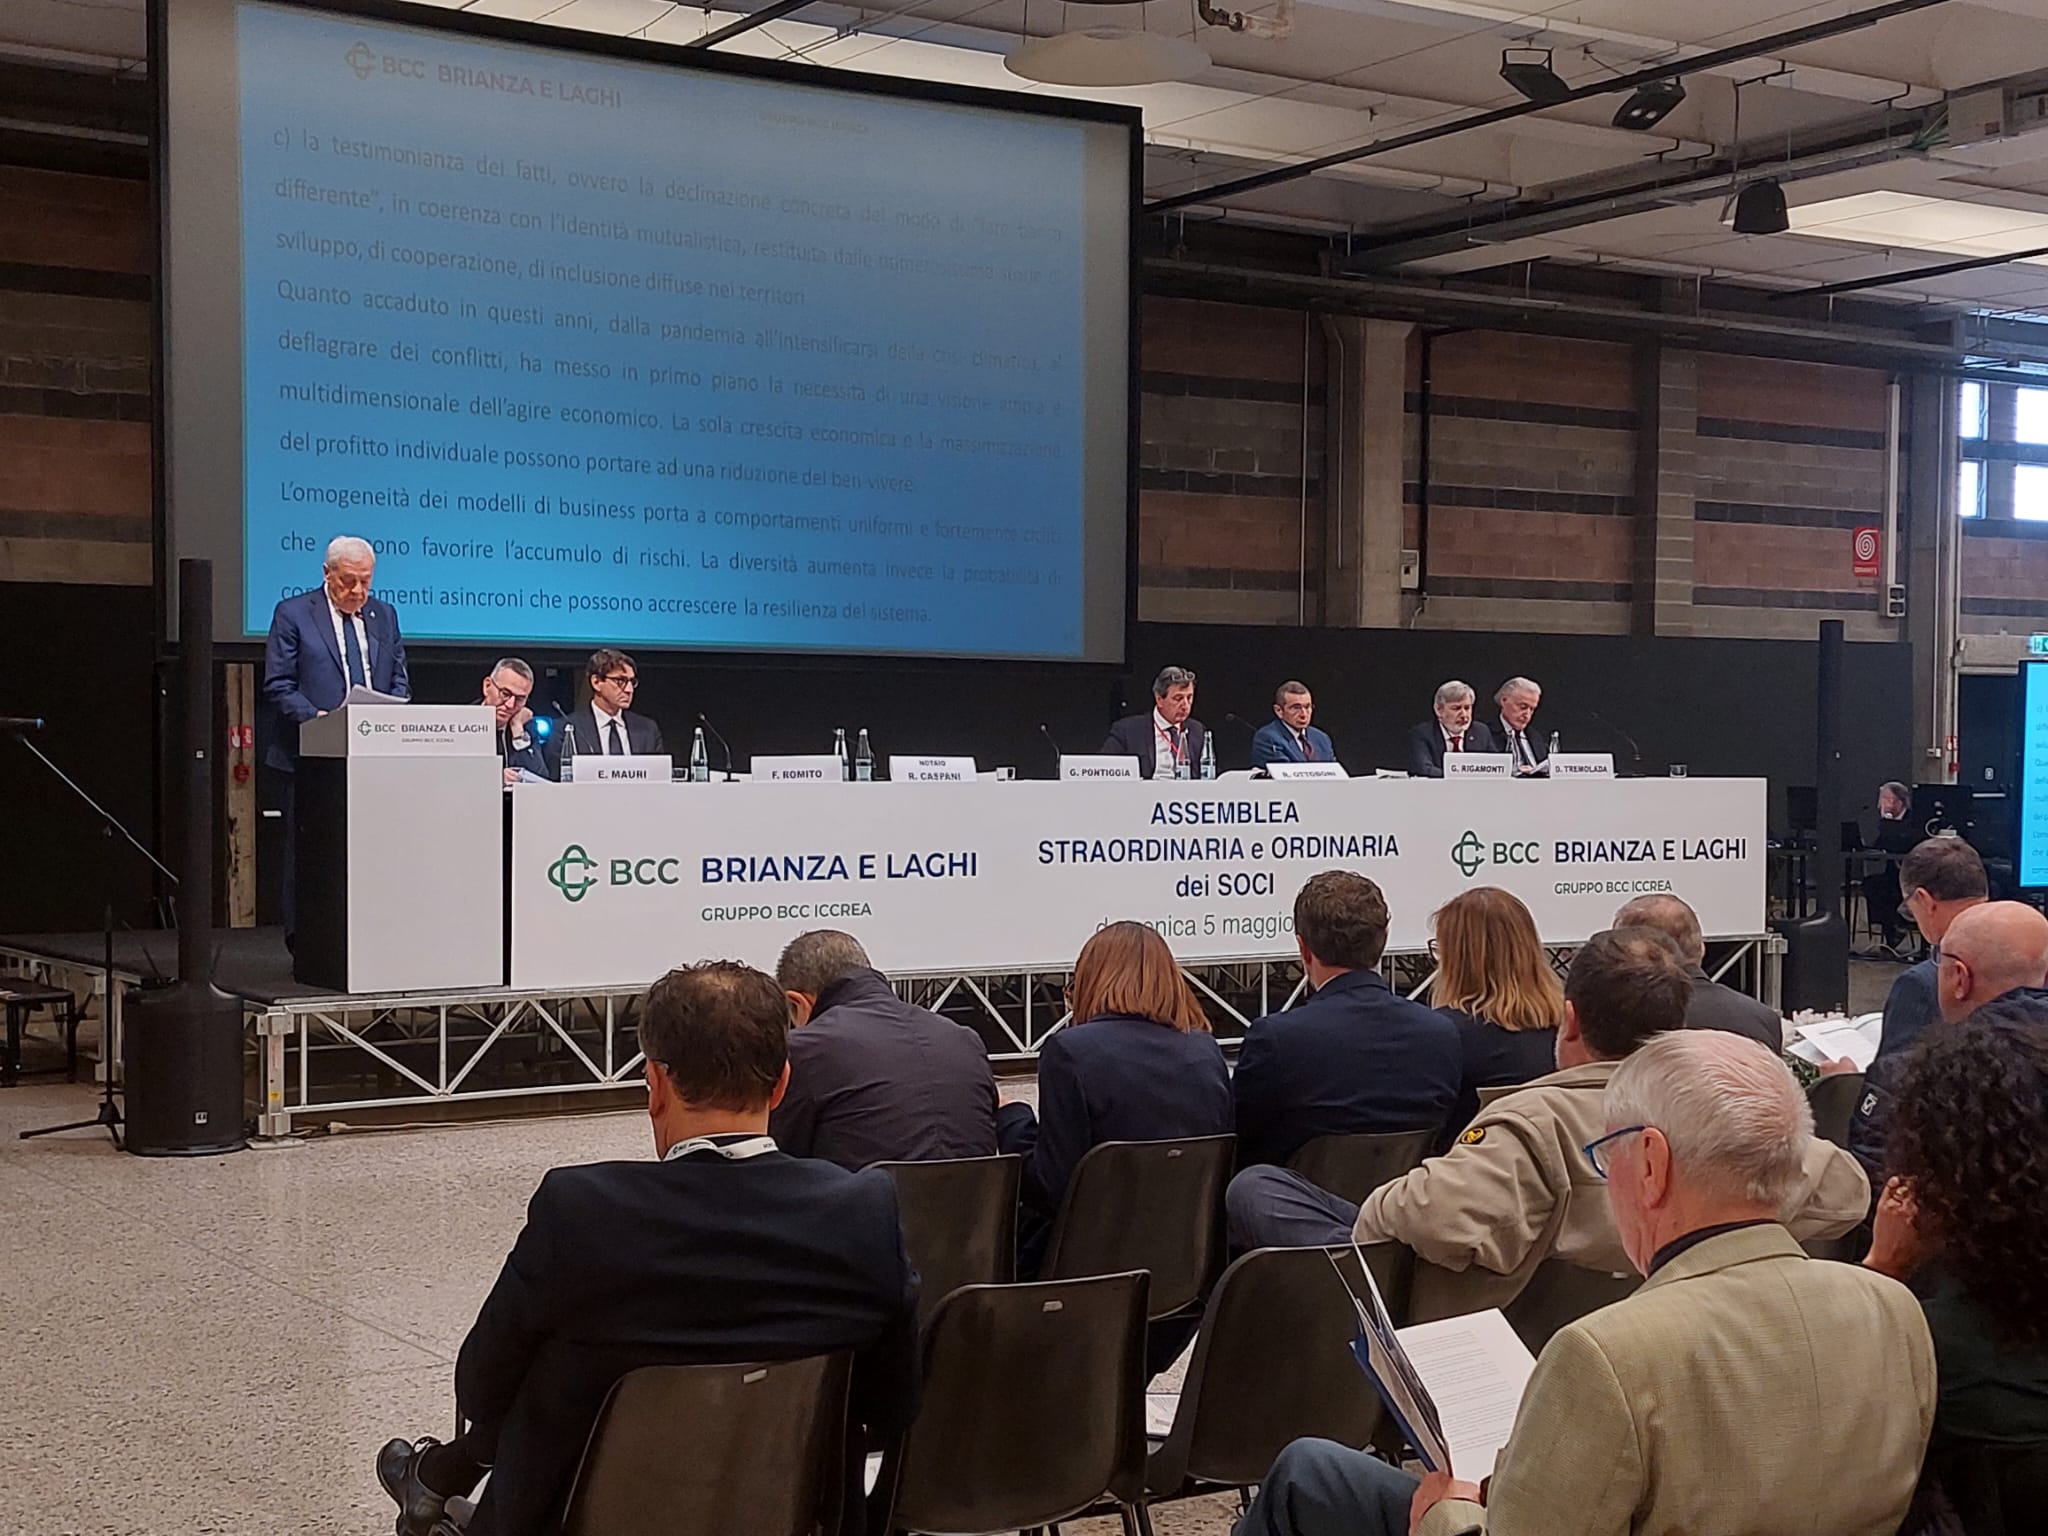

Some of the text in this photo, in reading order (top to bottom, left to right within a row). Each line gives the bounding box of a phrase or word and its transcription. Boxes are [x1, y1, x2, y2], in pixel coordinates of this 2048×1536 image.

[383, 57, 621, 108] BCC BRIANZA E LAGHI
[273, 128, 290, 149] c)
[303, 131, 320, 151] la
[332, 137, 464, 171] testimonianza
[477, 155, 504, 177] dei
[516, 160, 556, 187] fatti,
[568, 172, 628, 193] ovvero
[640, 176, 653, 196] la
[666, 180, 770, 210] declinazione
[393, 193, 410, 213] in
[418, 201, 500, 224] coerenza
[510, 212, 542, 229] con
[638, 227, 746, 256] mutualistica,
[275, 232, 362, 261] sviluppo,
[368, 240, 384, 260] di
[391, 247, 522, 279] cooperazione,
[528, 258, 545, 278] di
[550, 260, 641, 288] inclusione
[645, 271, 703, 295] diffuse
[709, 279, 733, 298] nei
[277, 279, 351, 305] Quanto
[362, 293, 448, 316] accaduto
[461, 299, 477, 319] in
[487, 307, 544, 326] questi
[554, 313, 598, 335] anni,
[608, 315, 650, 337] dalla
[661, 323, 745, 346] pandemia
[278, 330, 377, 358] deflagrare
[390, 341, 419, 362] dei
[432, 348, 508, 373] conflitti,
[520, 353, 542, 373] ha
[554, 361, 610, 379] messo
[622, 362, 638, 382] in
[649, 366, 701, 388] primo
[712, 371, 758, 393] piano
[769, 375, 783, 395] la
[280, 381, 459, 412] multidimensionale
[560, 407, 663, 429] economico.
[672, 412, 690, 431] La
[699, 415, 732, 435] sola
[740, 421, 802, 440] crescita
[810, 427, 896, 448] economica
[280, 430, 309, 451] del
[316, 435, 389, 456] profitto
[396, 438, 498, 464] individuale
[504, 451, 580, 470] possono
[587, 456, 650, 475] portare
[657, 458, 677, 477] ad
[684, 464, 714, 479] una
[721, 462, 798, 485] riduzione
[802, 467, 826, 487] del
[420, 489, 447, 509] dei
[457, 492, 526, 513] modelli
[534, 495, 550, 514] di
[559, 496, 635, 519] business
[644, 505, 689, 524] porta
[697, 509, 705, 523] a
[714, 510, 840, 531] comportamenti
[849, 514, 912, 535] uniformi
[281, 533, 316, 552] che
[422, 538, 493, 559] favorire
[613, 546, 628, 565] di
[640, 547, 690, 568] rischi.
[701, 550, 718, 569] La
[729, 551, 797, 573] diversità
[807, 559, 876, 577] aumenta
[886, 559, 932, 580] invece
[439, 588, 523, 608] asincroni
[530, 590, 562, 609] che
[568, 596, 643, 614] possono
[648, 598, 736, 615] accrescere
[745, 597, 758, 616] la
[763, 599, 837, 619] resilienza
[842, 601, 866, 620] del
[871, 602, 933, 623] sistema.
[375, 724, 395, 732] BCC
[598, 770, 646, 779] E. MAURI
[772, 770, 822, 779] F. ROMITO
[1151, 802, 1299, 824] ASSEMBLEA
[1039, 835, 1398, 864] STRAORDINARIA e ORDINARIA
[1493, 839, 1745, 864] BCC BRIANZA E LAGHI
[611, 853, 976, 885] BCC BRIANZA E LAGHI
[1176, 873, 1273, 897] dei SOCI
[1555, 880, 1672, 894] GRUPPO BCC ICCREA
[702, 903, 872, 921] GRUPPO BCC ICCREA
[1096, 911, 1294, 938] dnica 5 maggio
